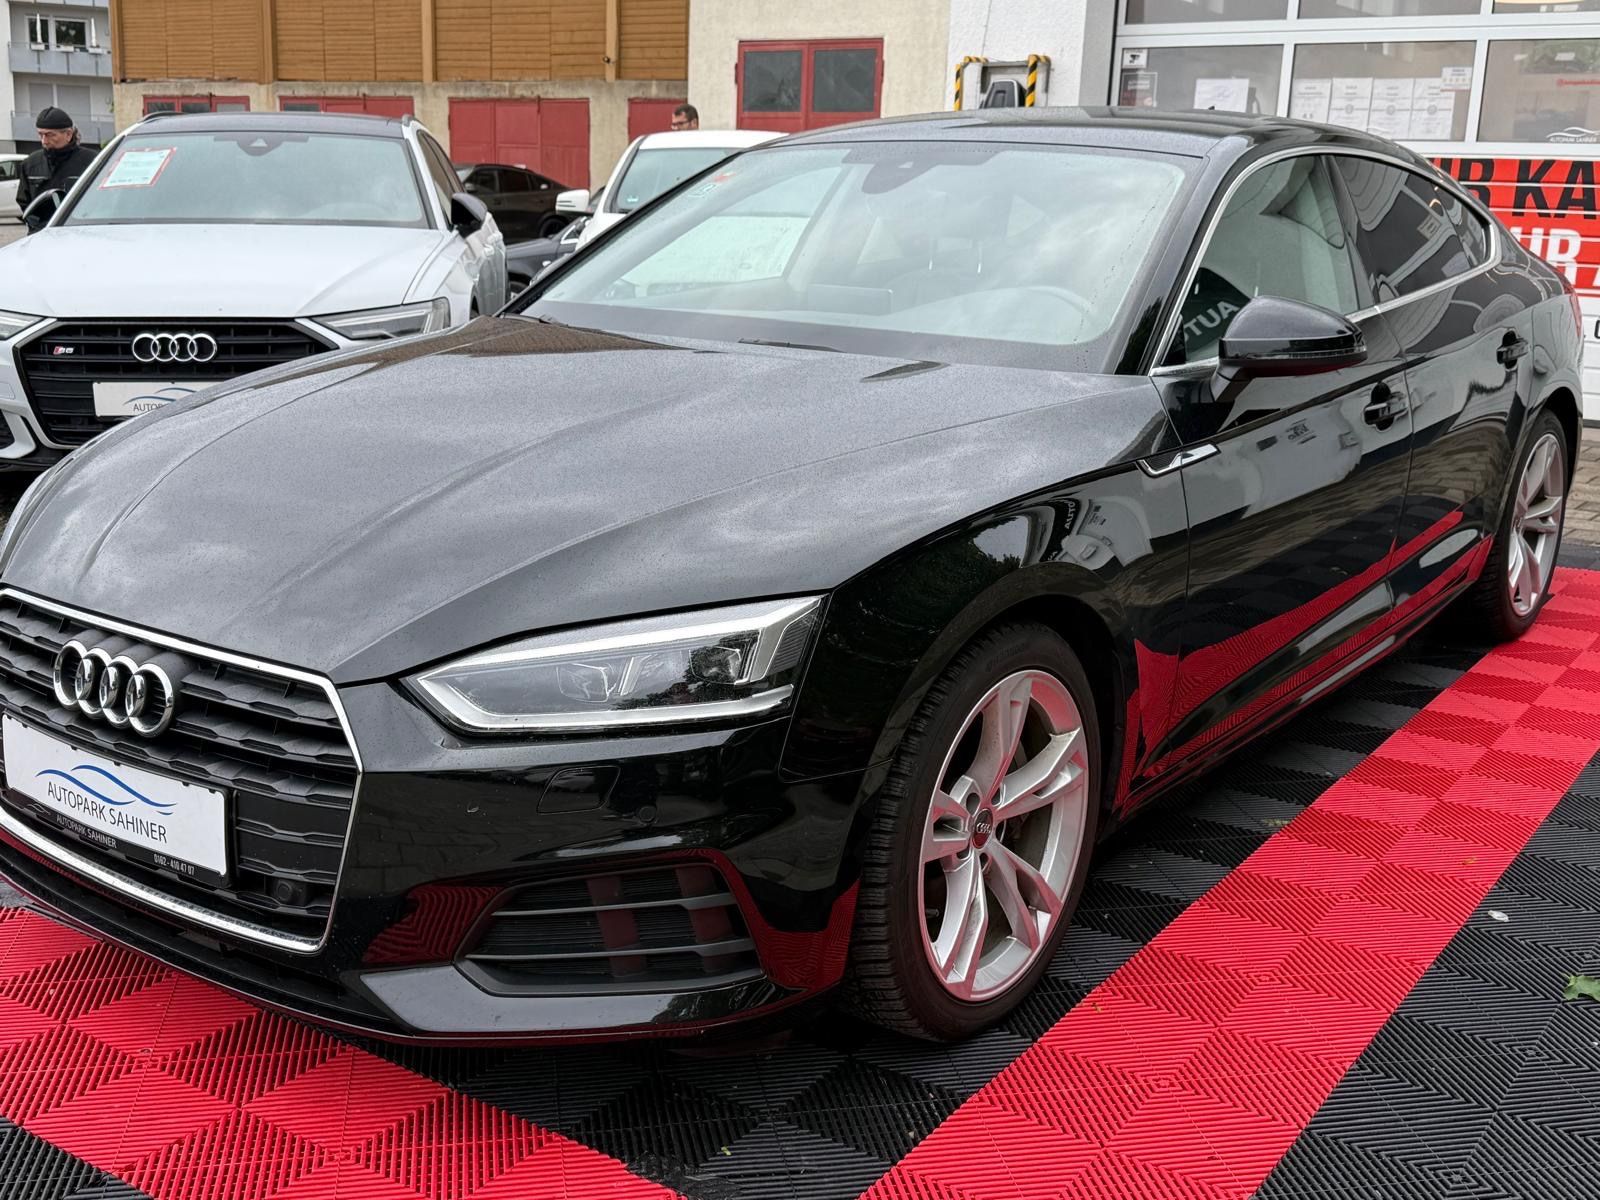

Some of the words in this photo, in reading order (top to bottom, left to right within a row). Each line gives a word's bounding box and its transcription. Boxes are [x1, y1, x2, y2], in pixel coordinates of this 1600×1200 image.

[47, 781, 107, 822] AUTOPARK
[109, 808, 167, 843] SAHINER
[56, 814, 87, 836] AUTOPARK
[87, 828, 117, 849] SAHINER
